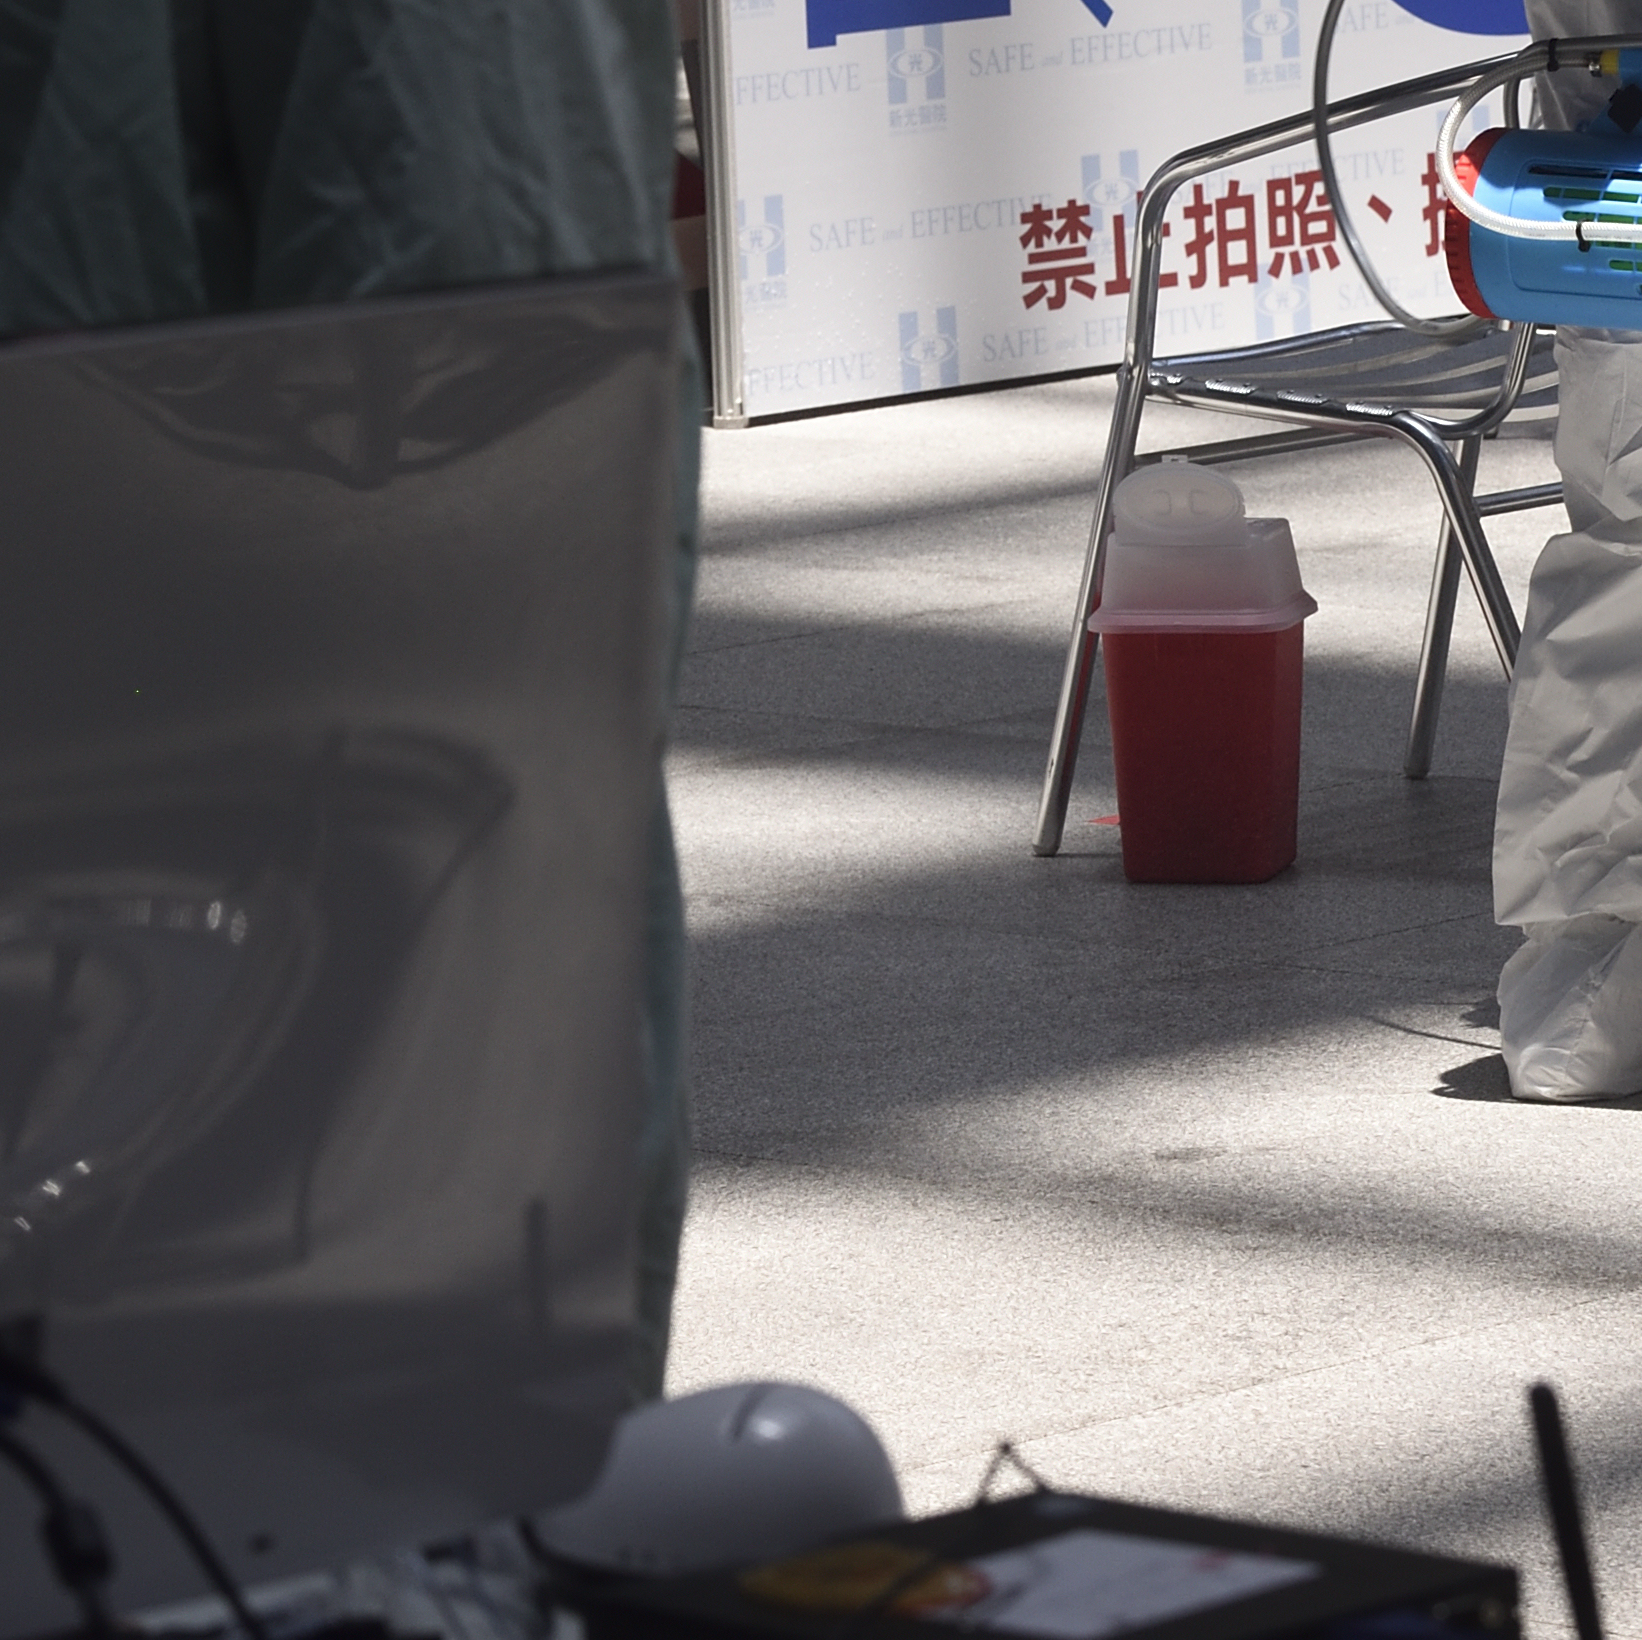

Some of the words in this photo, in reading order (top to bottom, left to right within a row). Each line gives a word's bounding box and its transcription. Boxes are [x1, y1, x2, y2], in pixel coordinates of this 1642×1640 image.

[969, 44, 1035, 77] SAFE
[1070, 23, 1213, 66] EFFECTIVE
[736, 64, 860, 106] FFECTIVE
[809, 216, 875, 253] SAFE
[1020, 151, 1455, 310] 禁止拍照、
[982, 327, 1049, 362] SAFE
[747, 351, 875, 397] FFECTIVE
